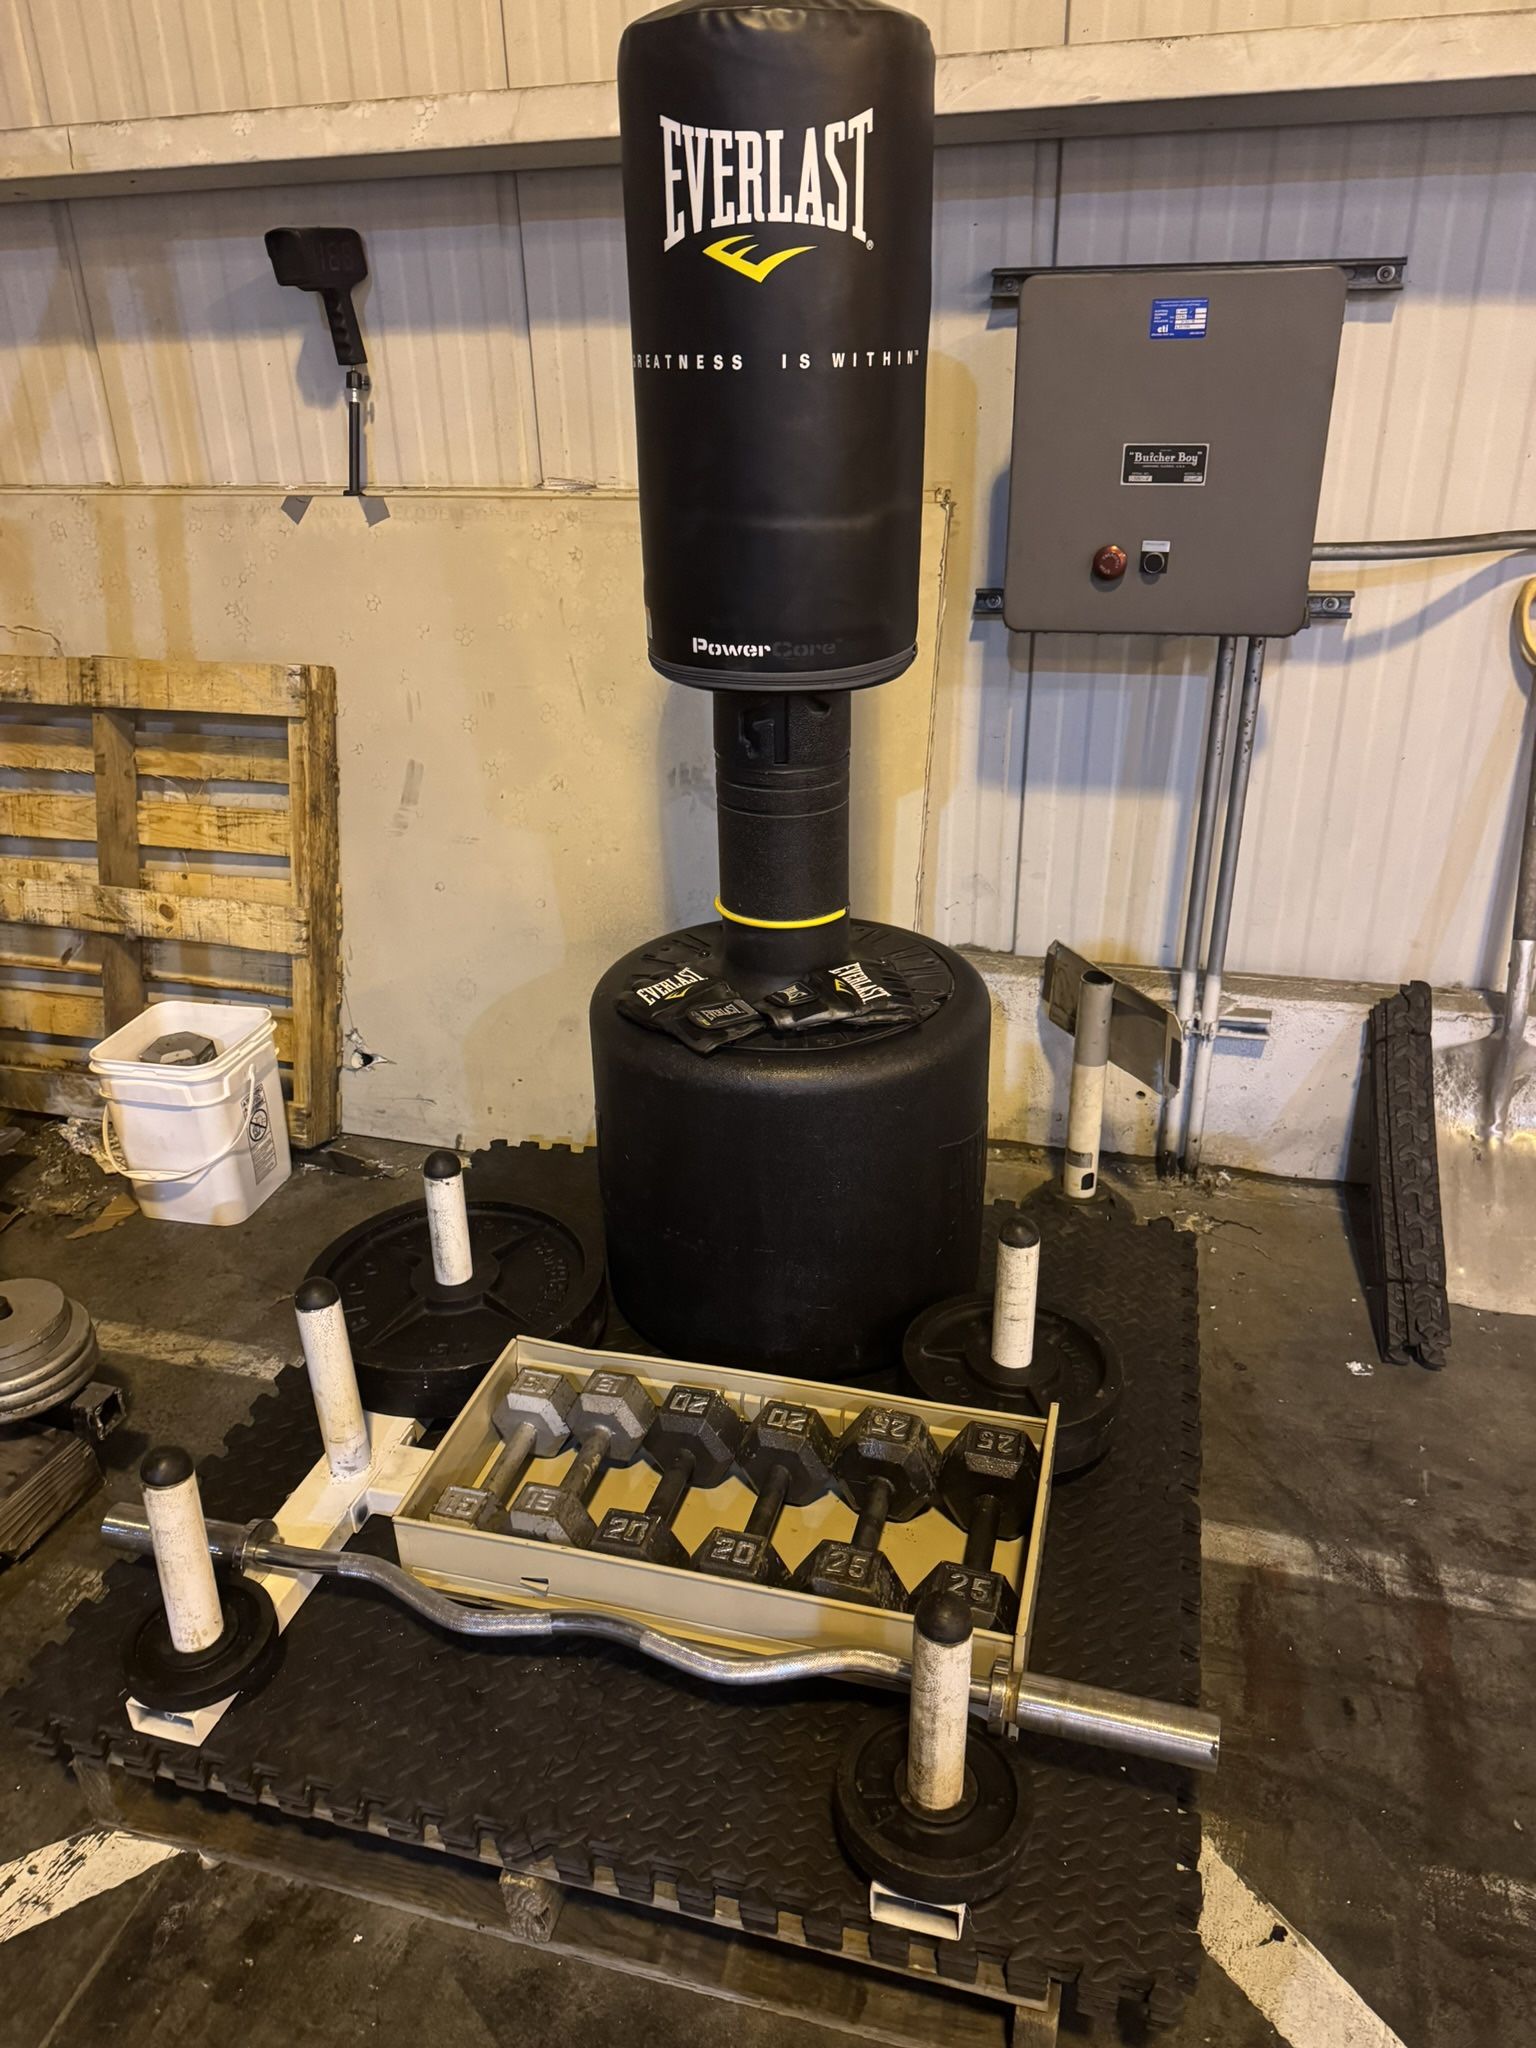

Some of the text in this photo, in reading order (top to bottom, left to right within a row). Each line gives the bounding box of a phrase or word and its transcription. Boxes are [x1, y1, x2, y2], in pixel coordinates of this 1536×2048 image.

[659, 107, 874, 253] EVERLAST
[782, 353, 811, 369] IS
[636, 966, 707, 1007] EVERLAST
[828, 962, 892, 1005] EVERLAST
[669, 1391, 711, 1415] 20
[766, 1408, 808, 1431] 20
[871, 1414, 911, 1438] 25
[976, 1430, 1016, 1453] 25
[524, 1488, 557, 1511] 15
[603, 1516, 650, 1544] 20
[711, 1536, 758, 1566] 20
[825, 1549, 867, 1579] 25
[948, 1572, 992, 1602] 25
